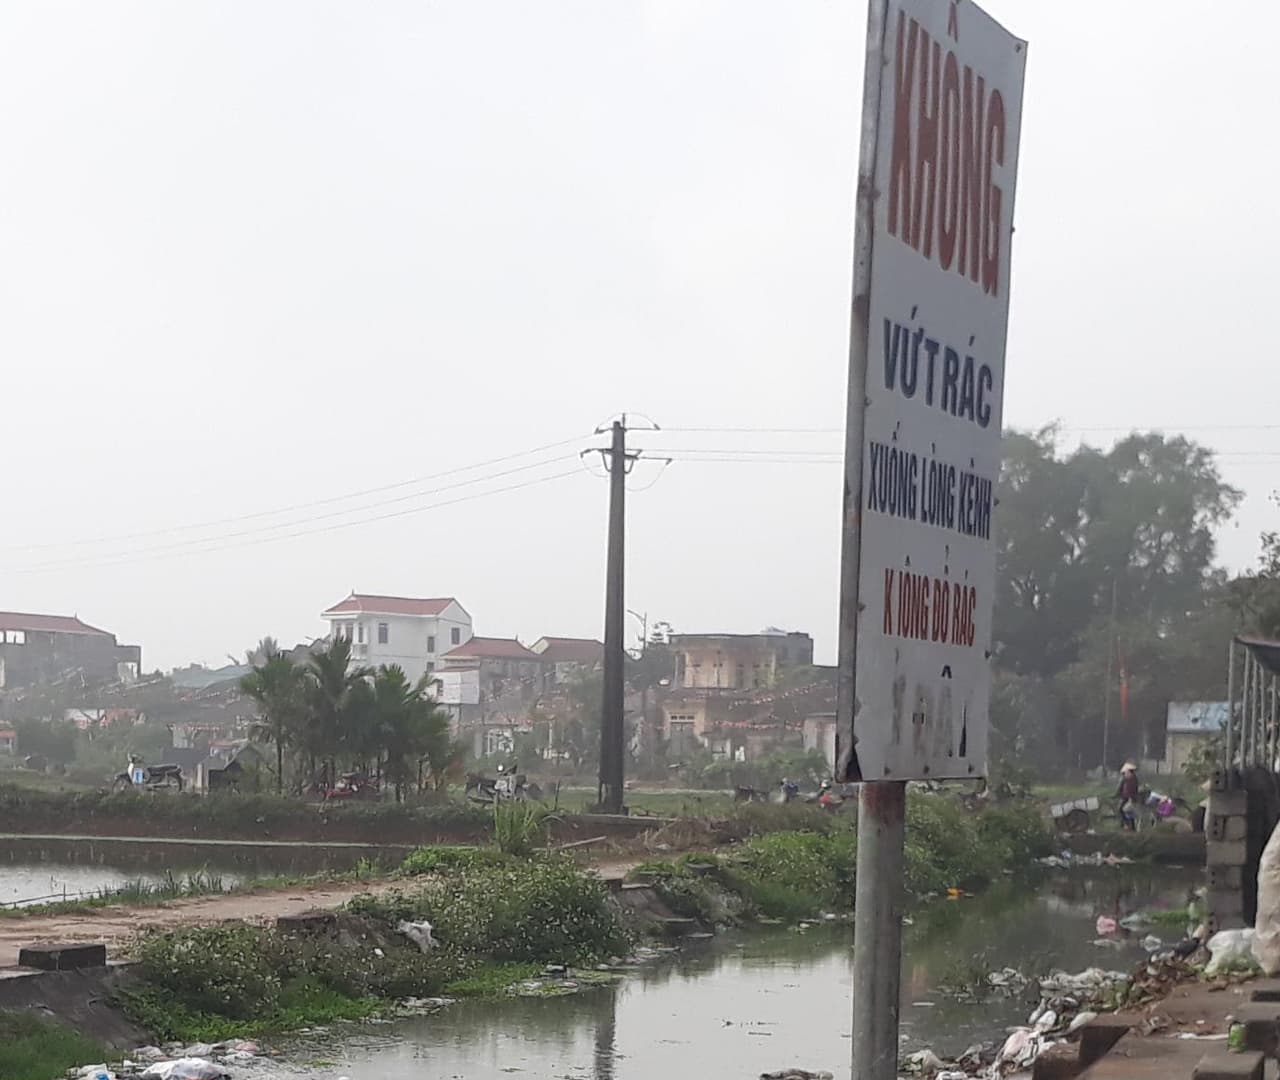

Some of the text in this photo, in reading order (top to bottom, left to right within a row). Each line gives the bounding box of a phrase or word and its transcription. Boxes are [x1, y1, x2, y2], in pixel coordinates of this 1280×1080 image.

[887, 2, 1006, 298] KHÔNG
[941, 335, 993, 429] RÁC
[868, 421, 917, 520] XUỐNG
[958, 457, 992, 540] KÊNH
[952, 570, 976, 647] RÁC
